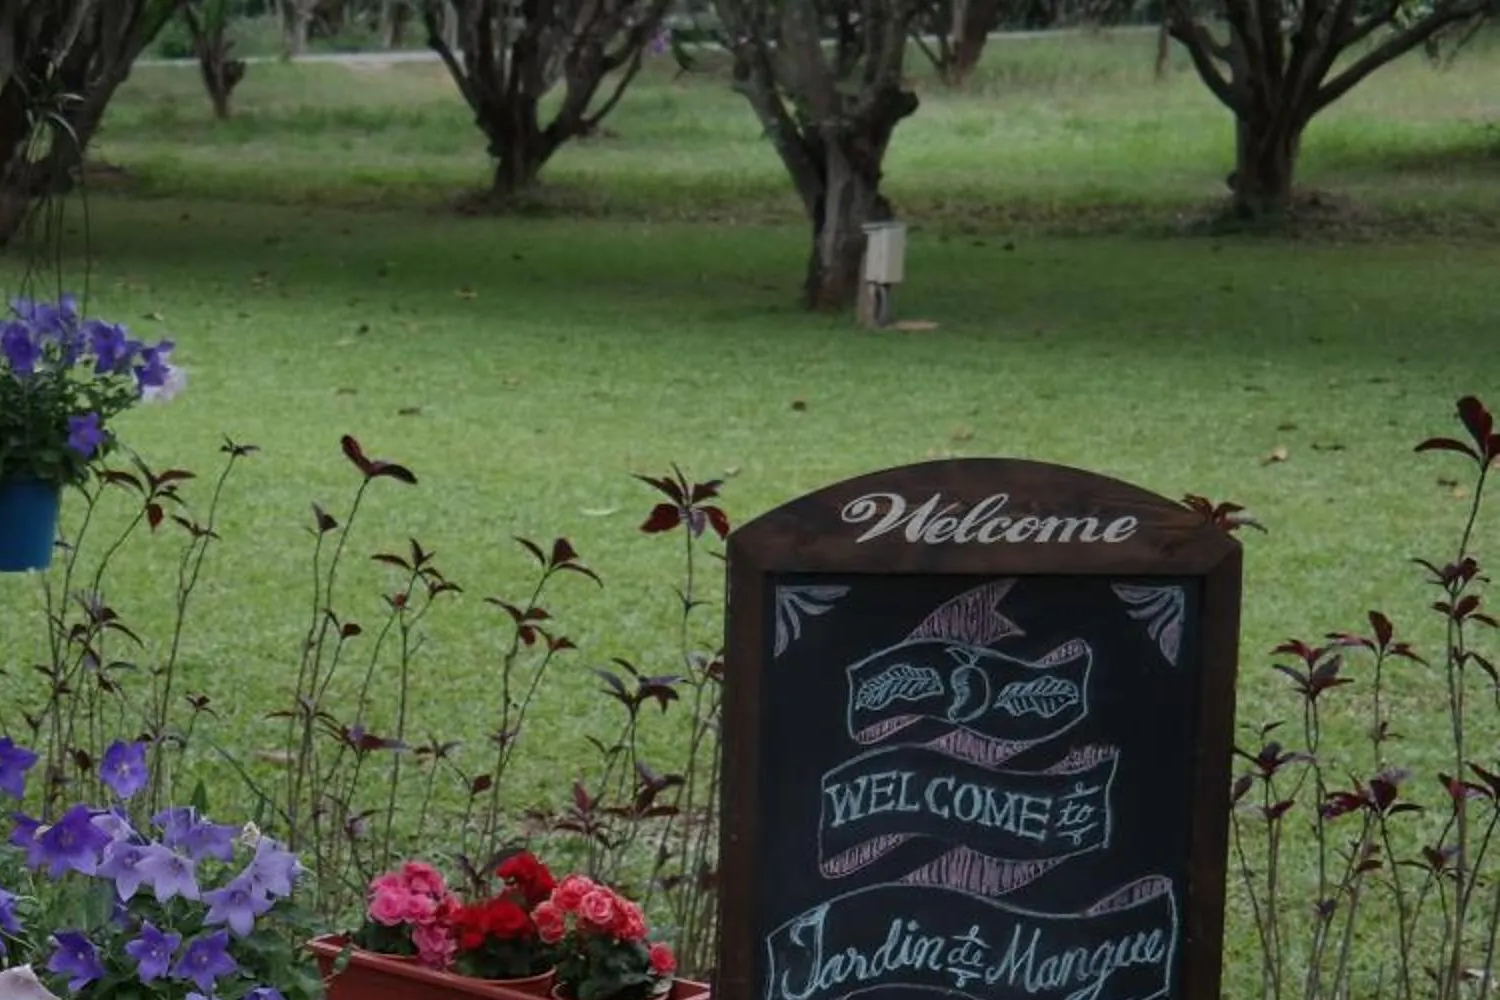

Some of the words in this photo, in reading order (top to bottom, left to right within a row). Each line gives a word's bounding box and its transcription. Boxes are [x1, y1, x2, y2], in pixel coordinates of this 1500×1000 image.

[841, 492, 1138, 544] Welcome
[824, 770, 1052, 840] WELCOME
[1055, 792, 1097, 834] to
[946, 934, 988, 977] de
